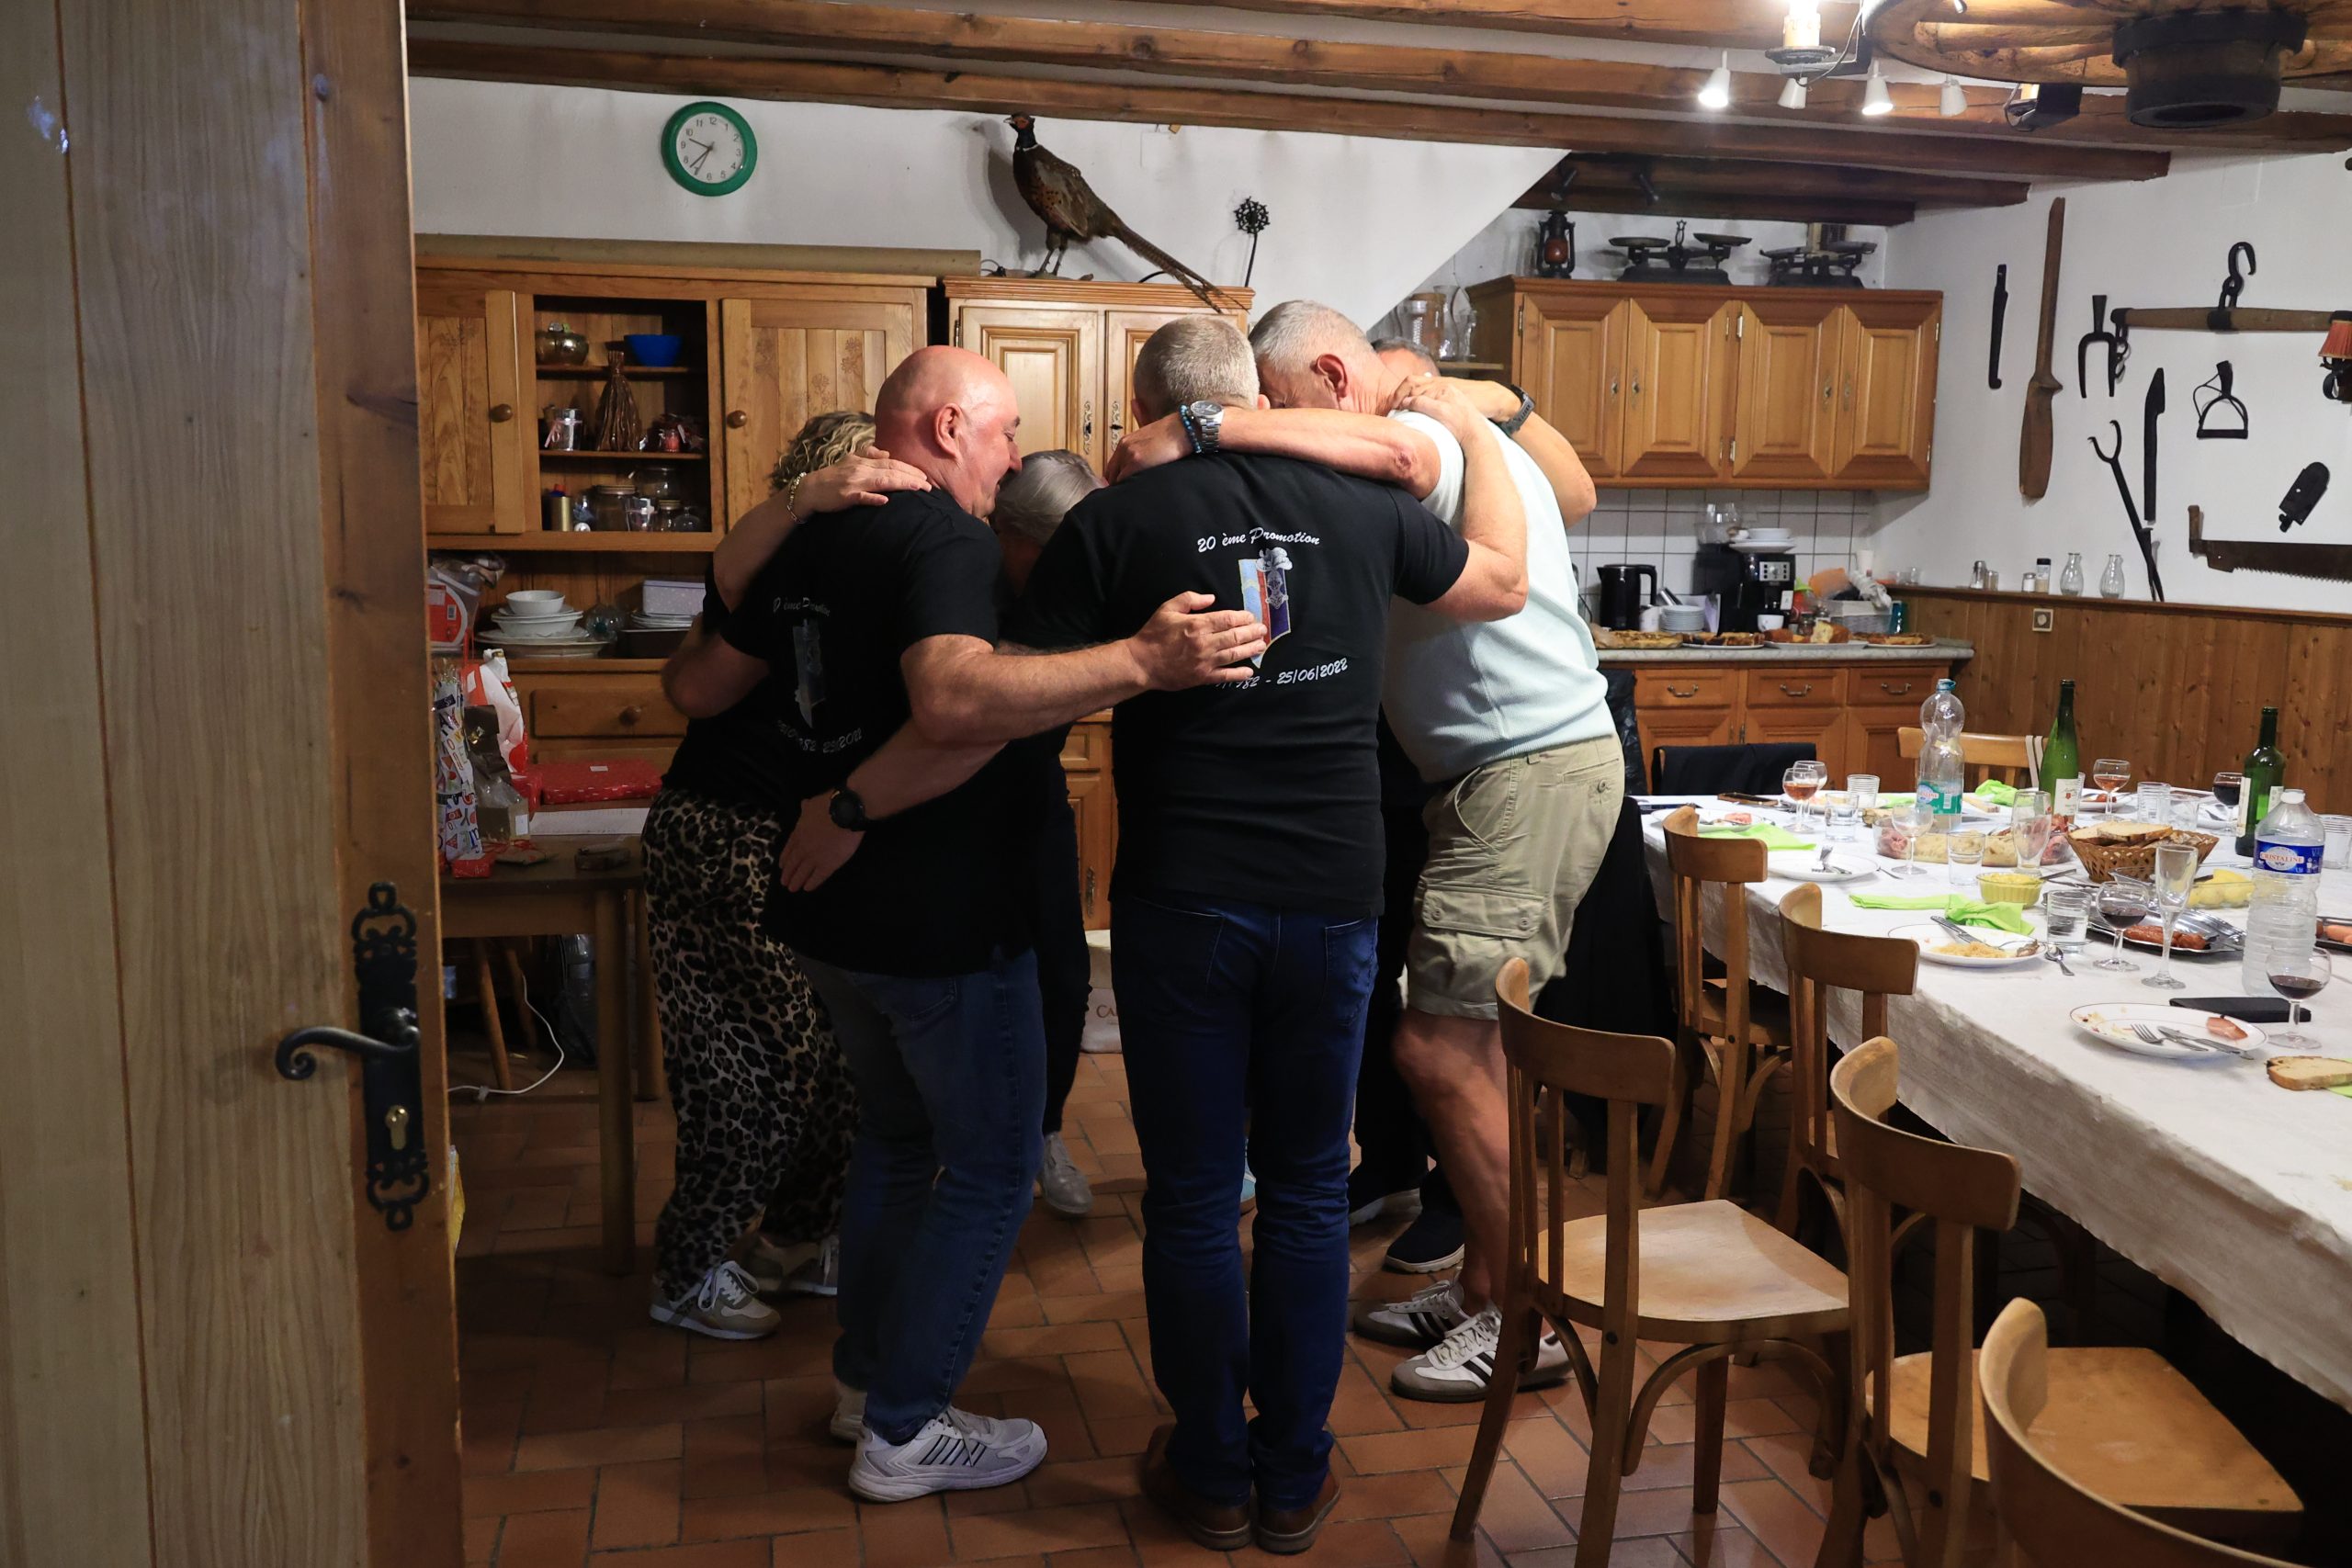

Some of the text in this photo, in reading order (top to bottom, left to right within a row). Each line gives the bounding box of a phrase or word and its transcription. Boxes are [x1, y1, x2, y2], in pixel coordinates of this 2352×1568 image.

[709, 117, 717, 125] 12
[1197, 527, 1320, 552] 20 ème Promotion
[1277, 658, 1348, 684] 25/06/2022
[2261, 852, 2302, 863] CRISTALINE
